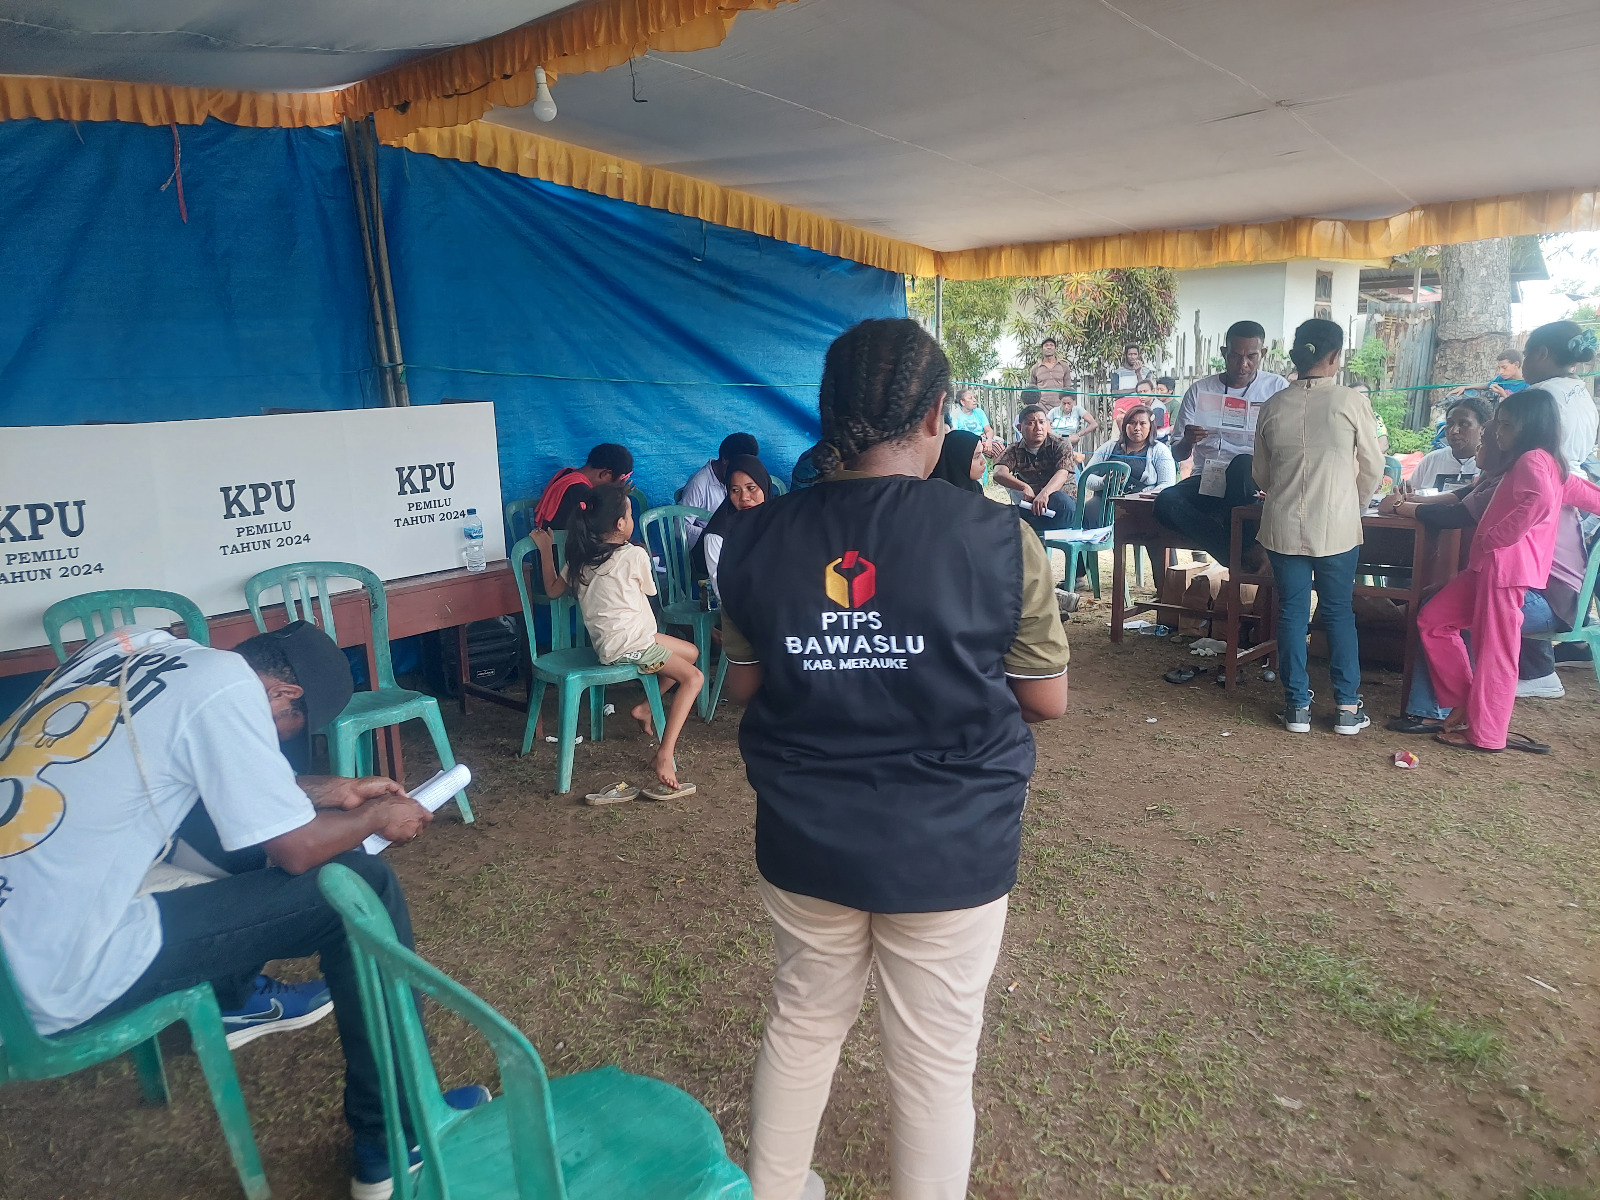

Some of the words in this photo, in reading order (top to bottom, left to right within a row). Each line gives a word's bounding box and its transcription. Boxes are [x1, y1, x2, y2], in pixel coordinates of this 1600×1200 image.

[395, 461, 455, 496] KPU
[219, 479, 296, 520] KPU
[407, 498, 451, 511] PEMILU
[0, 500, 86, 543] KPU
[394, 514, 435, 527] TAHUN
[438, 510, 466, 521] 2024
[236, 521, 292, 538] PEMILU
[219, 539, 271, 556] TAHUN
[276, 534, 311, 548] 2024
[5, 547, 79, 565] PEMILU
[0, 568, 51, 584] AHUN
[58, 562, 104, 578] 2024
[821, 611, 883, 630] PTPS
[784, 634, 925, 654] BAWASLU
[803, 659, 836, 671] KAB.
[839, 657, 909, 670] MERAUKE
